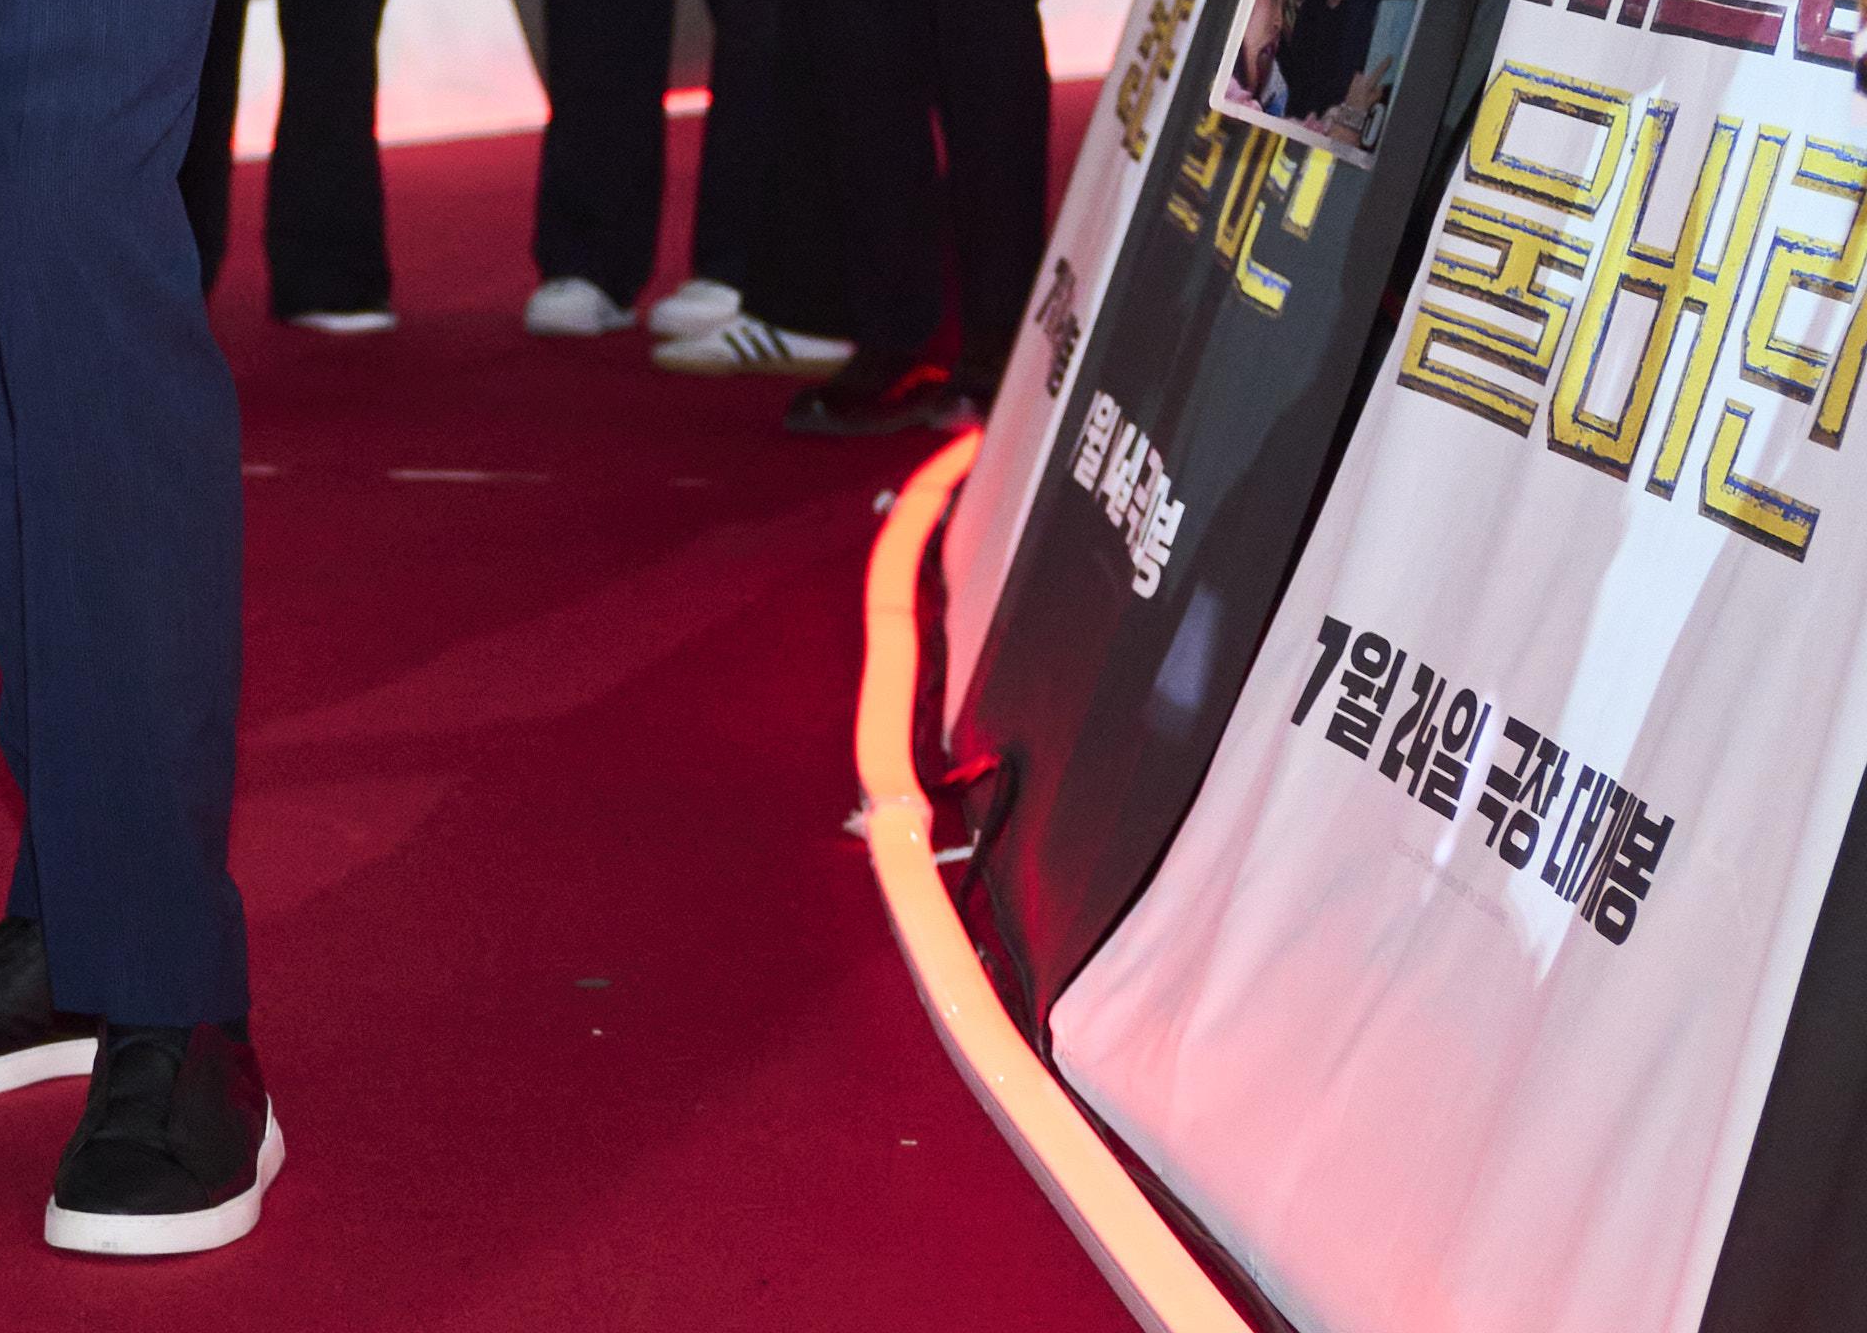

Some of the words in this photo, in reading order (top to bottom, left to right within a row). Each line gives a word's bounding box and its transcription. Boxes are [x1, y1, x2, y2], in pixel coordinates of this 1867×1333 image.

[1290, 614, 1408, 762] 7월
[1378, 662, 1492, 822] 24일
[1476, 715, 1571, 871] 극장
[1539, 763, 1676, 946] 대개봉
